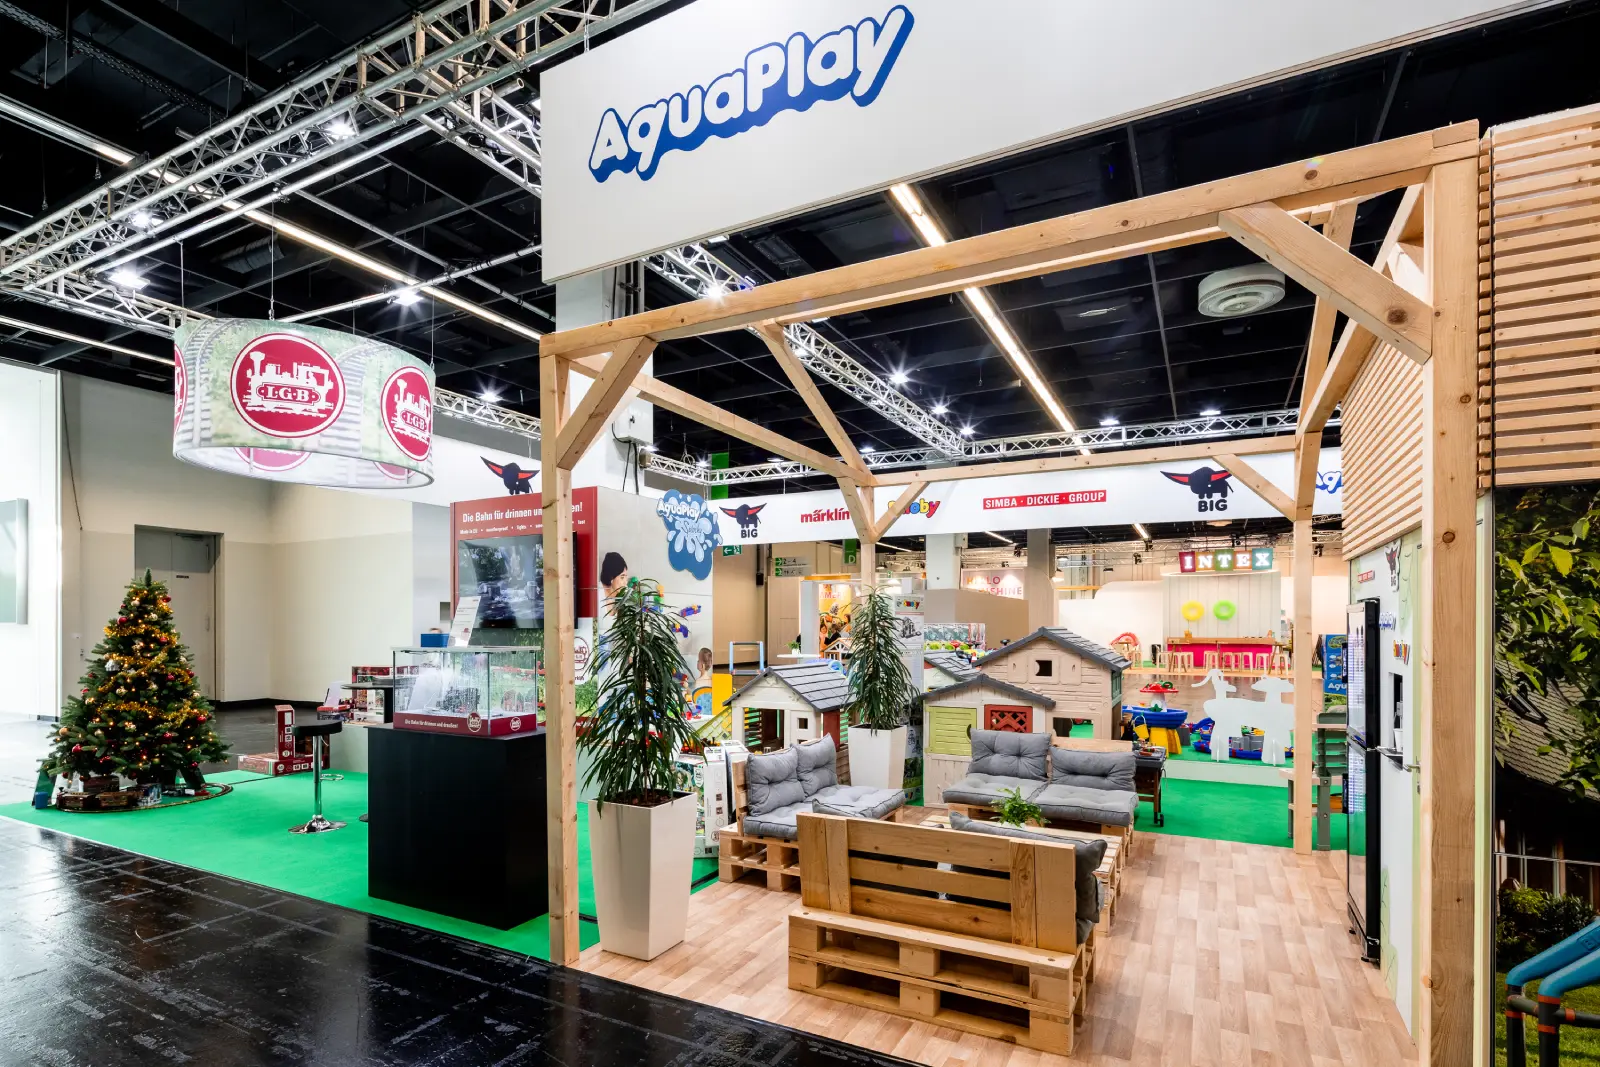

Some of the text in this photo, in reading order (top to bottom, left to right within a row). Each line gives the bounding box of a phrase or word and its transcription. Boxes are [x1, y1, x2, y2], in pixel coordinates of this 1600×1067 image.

[589, 4, 915, 183] AquaPlay
[985, 491, 1105, 508] SIMBA DICKIE GROUP
[1197, 499, 1228, 512] BIG
[462, 508, 543, 523] Die Bahn für drinnen un
[656, 498, 701, 523] AquaPlay
[740, 528, 758, 539] BIG
[1183, 552, 1270, 569] INTEX
